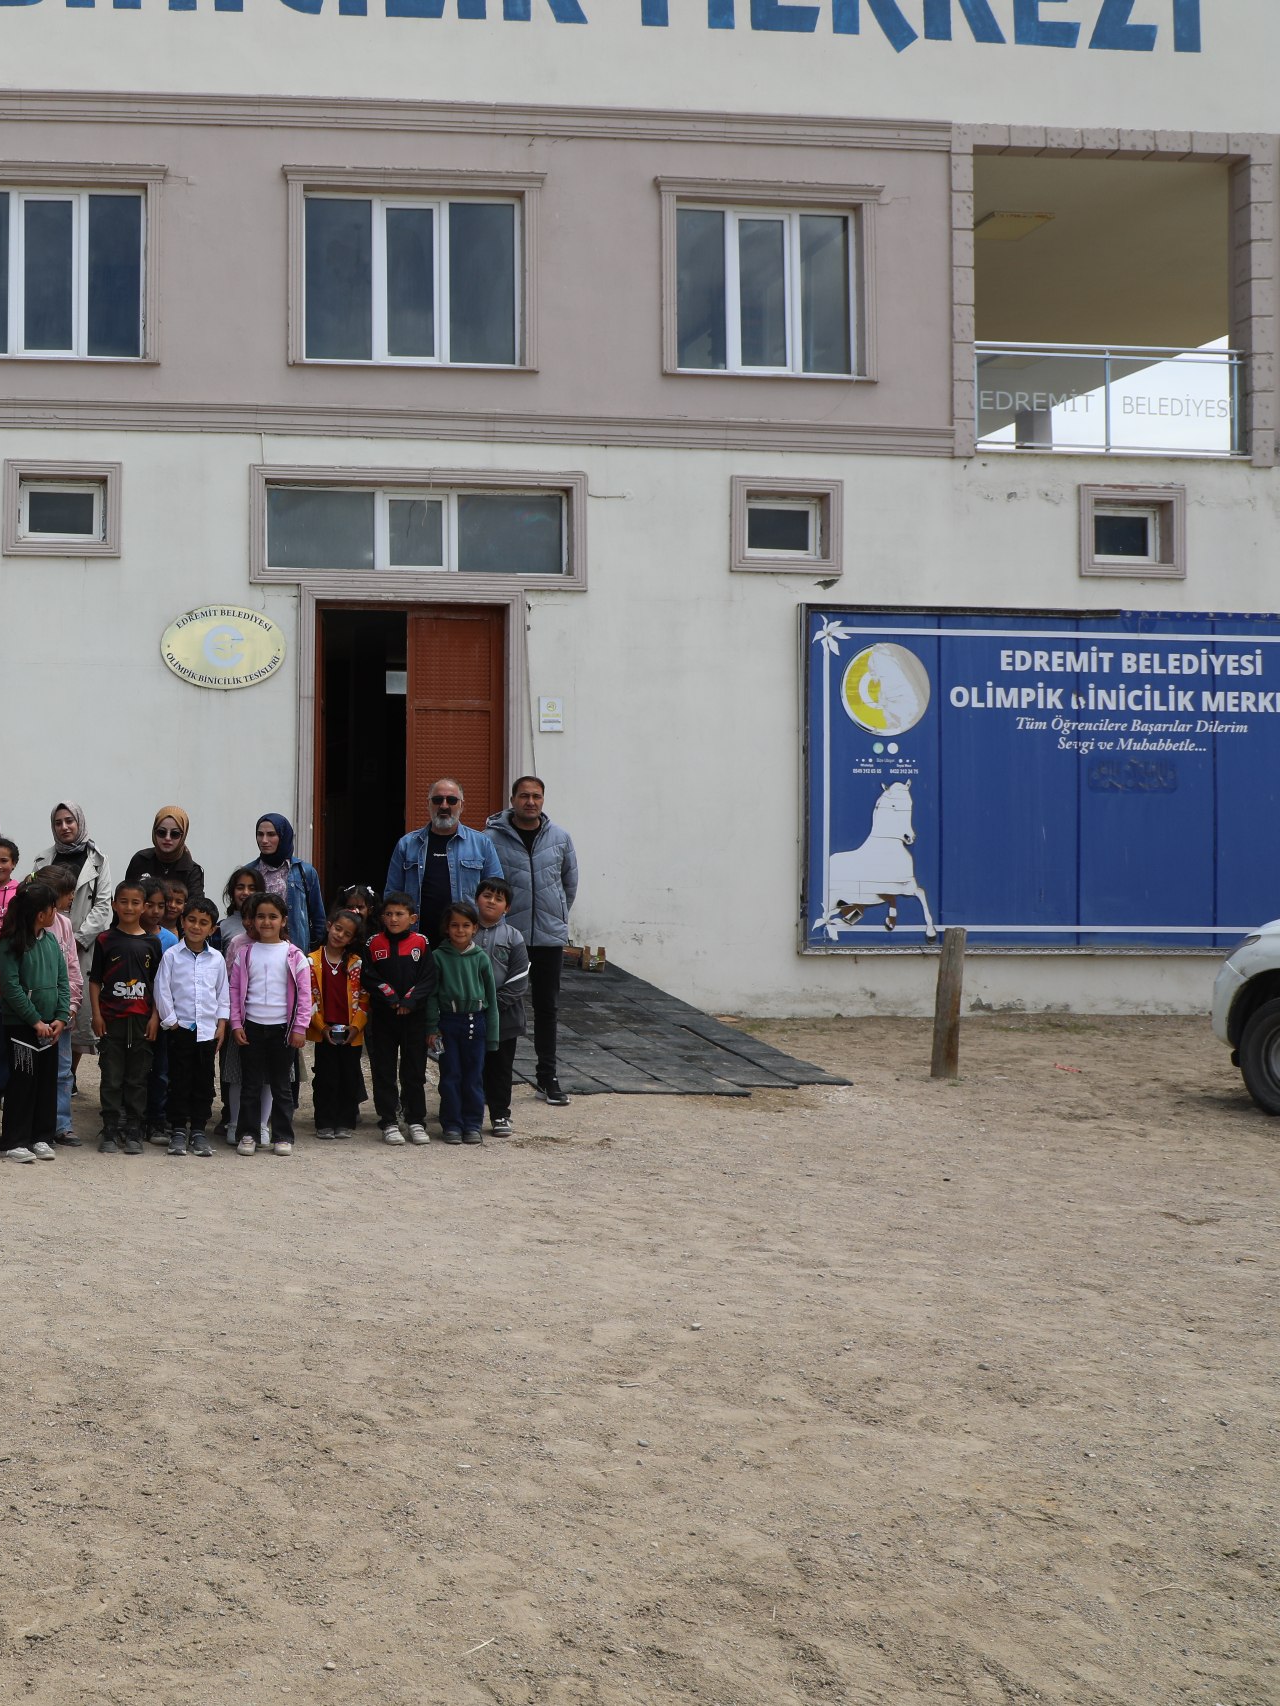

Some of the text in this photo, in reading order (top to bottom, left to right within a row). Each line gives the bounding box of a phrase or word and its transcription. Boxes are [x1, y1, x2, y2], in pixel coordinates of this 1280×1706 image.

[979, 389, 1234, 418] EDREMİT BELEDİYESİ
[176, 607, 273, 632] EDREMİT BELEDİYESİ
[166, 652, 281, 685] OLİMPİK BİNİCİLİK TESİSLERİ
[1000, 646, 1262, 676] EDREMİT BELEDİYESİ
[950, 681, 1064, 709] OLİMPİK
[1015, 715, 1248, 735] Tüm Öğrencilere Başarılar Dilerim
[1057, 736, 1095, 754] Sevgi
[1098, 740, 1114, 751] ve
